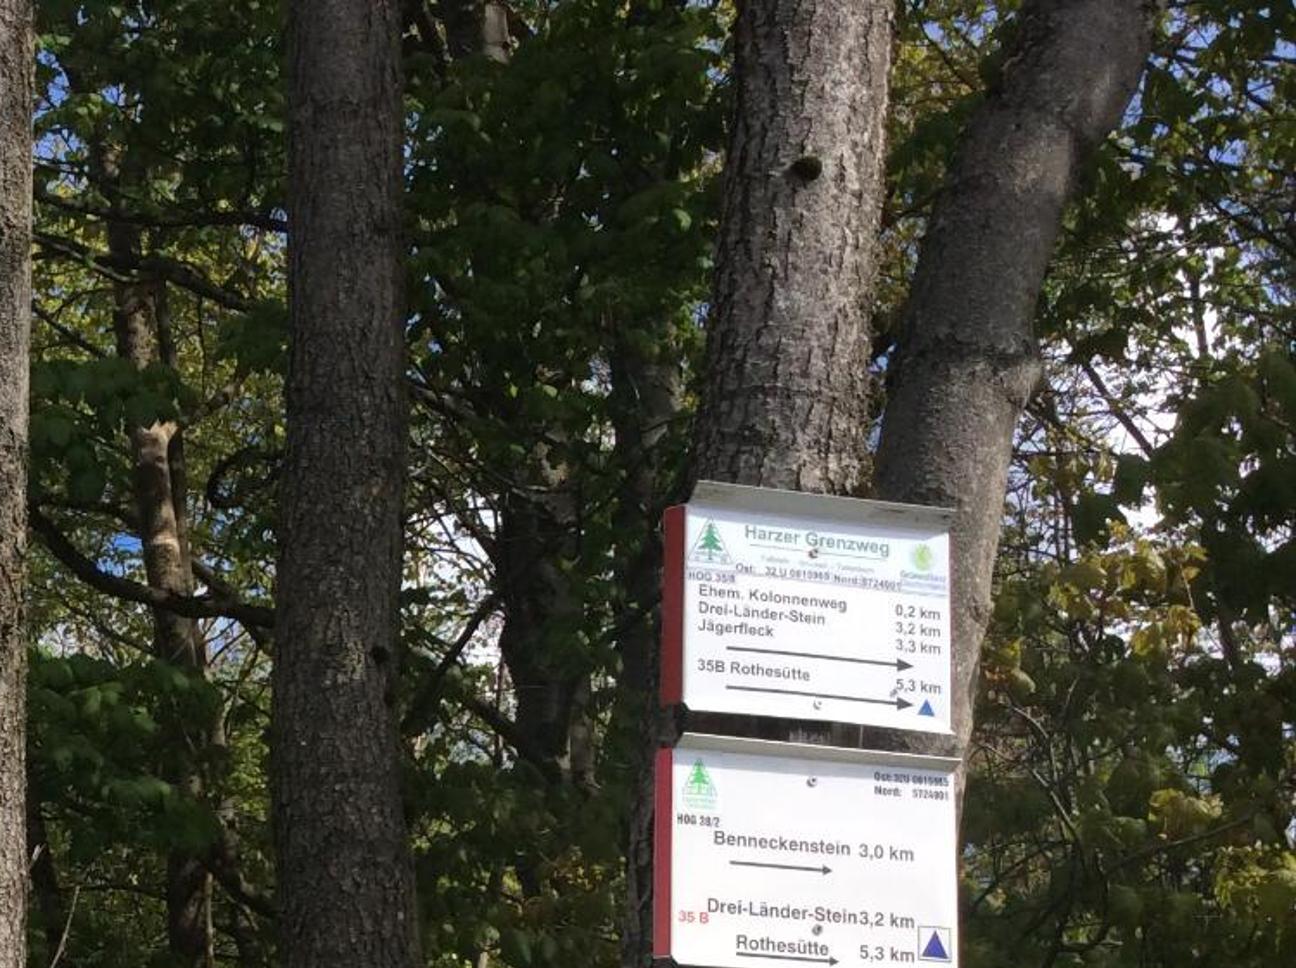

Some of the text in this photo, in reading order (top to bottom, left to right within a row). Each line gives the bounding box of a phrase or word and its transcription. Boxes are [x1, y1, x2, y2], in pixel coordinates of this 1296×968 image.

[745, 525, 889, 557] Harzer Grenzweg
[699, 584, 941, 621] Ehem. Kolonnenweg 0,2 km
[698, 601, 941, 638] Drei-Länder-Stein 3,2 km
[698, 618, 942, 656] Jägerfleck 3,3 km
[698, 659, 810, 681] 35B Rothesütte
[895, 678, 942, 695] 5,3 km
[714, 830, 915, 862] Benneckenstein 3,0 km
[707, 898, 916, 929] Drei-Länder-Stein 3,2 km
[736, 934, 916, 963] Rothesütte 5,3 km
